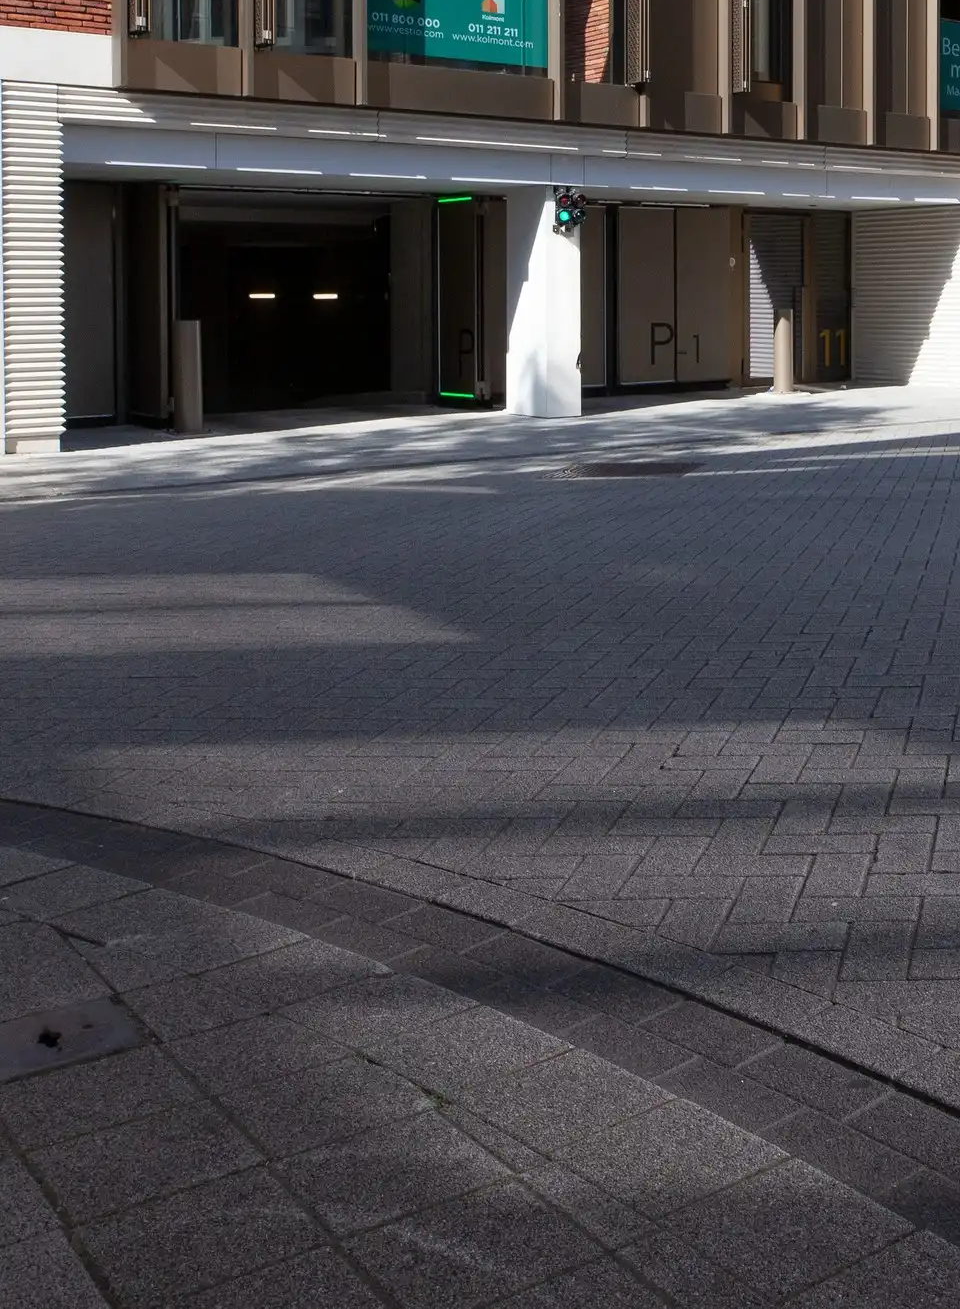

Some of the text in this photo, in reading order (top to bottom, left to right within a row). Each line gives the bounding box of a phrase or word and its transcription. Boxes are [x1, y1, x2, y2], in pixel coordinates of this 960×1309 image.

[371, 11, 441, 29] 011 800 000
[367, 24, 444, 39] www.vestio.com
[468, 23, 519, 38] 011 211 211
[452, 32, 534, 49] www.kolmont.com
[819, 328, 845, 367] 11
